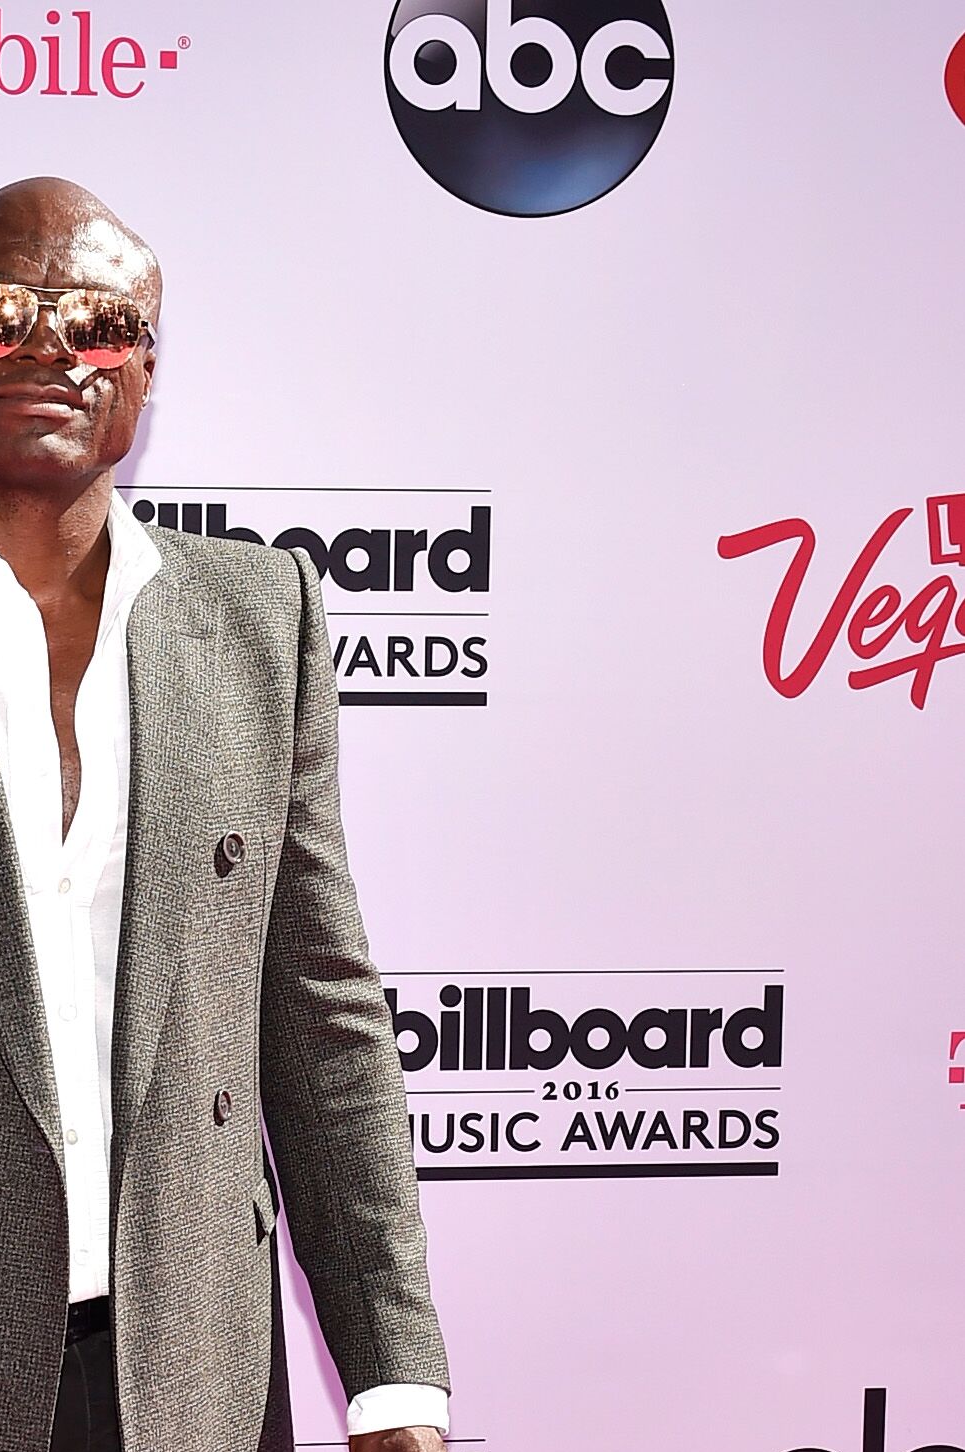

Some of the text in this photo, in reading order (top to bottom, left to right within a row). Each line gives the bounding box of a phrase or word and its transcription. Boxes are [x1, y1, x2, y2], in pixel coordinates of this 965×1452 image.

[390, 0, 670, 115] abc
[718, 508, 965, 710] Veg
[383, 984, 783, 1072] billboard
[408, 1110, 779, 1153] USIC AWARDS
[542, 1081, 618, 1100] 2016
